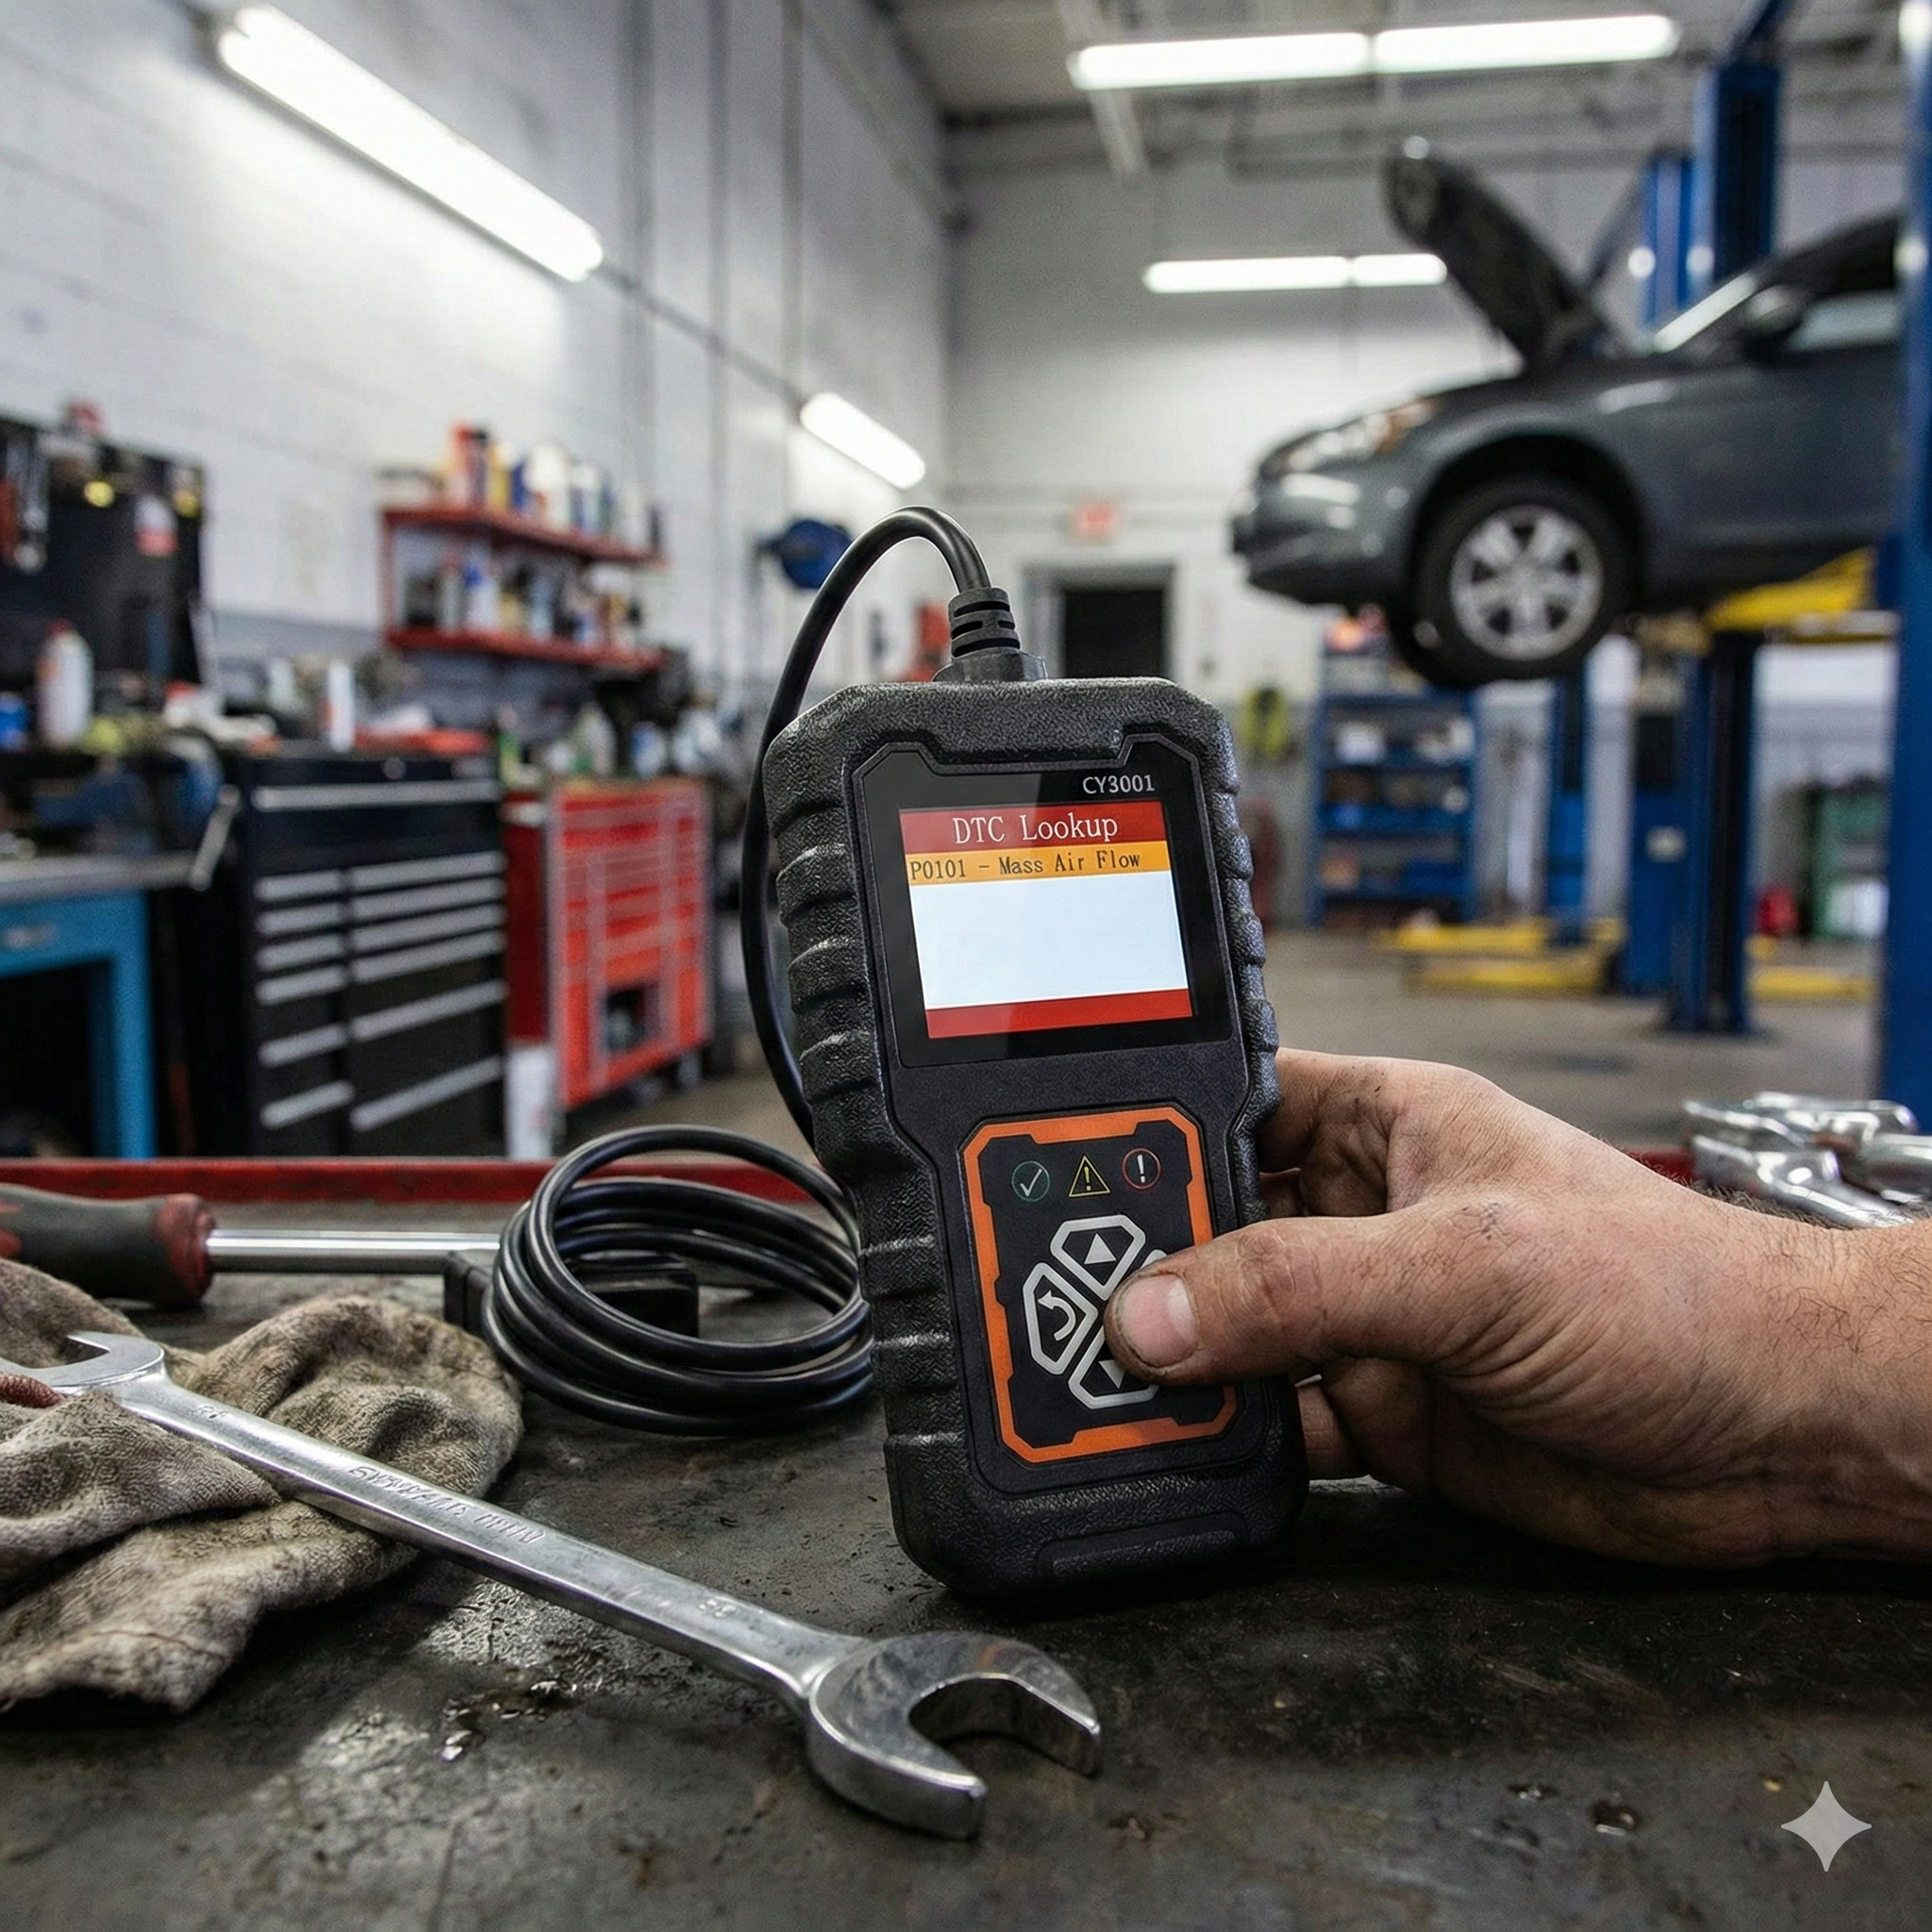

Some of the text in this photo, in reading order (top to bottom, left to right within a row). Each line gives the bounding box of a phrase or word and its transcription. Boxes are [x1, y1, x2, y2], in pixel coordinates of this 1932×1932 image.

[1082, 774, 1156, 794] CY3001
[953, 812, 1119, 844] DTC Lookup
[909, 859, 967, 881] P0101
[999, 856, 1044, 876] Mass
[1055, 852, 1084, 873] Air
[1097, 850, 1141, 870] Flow
